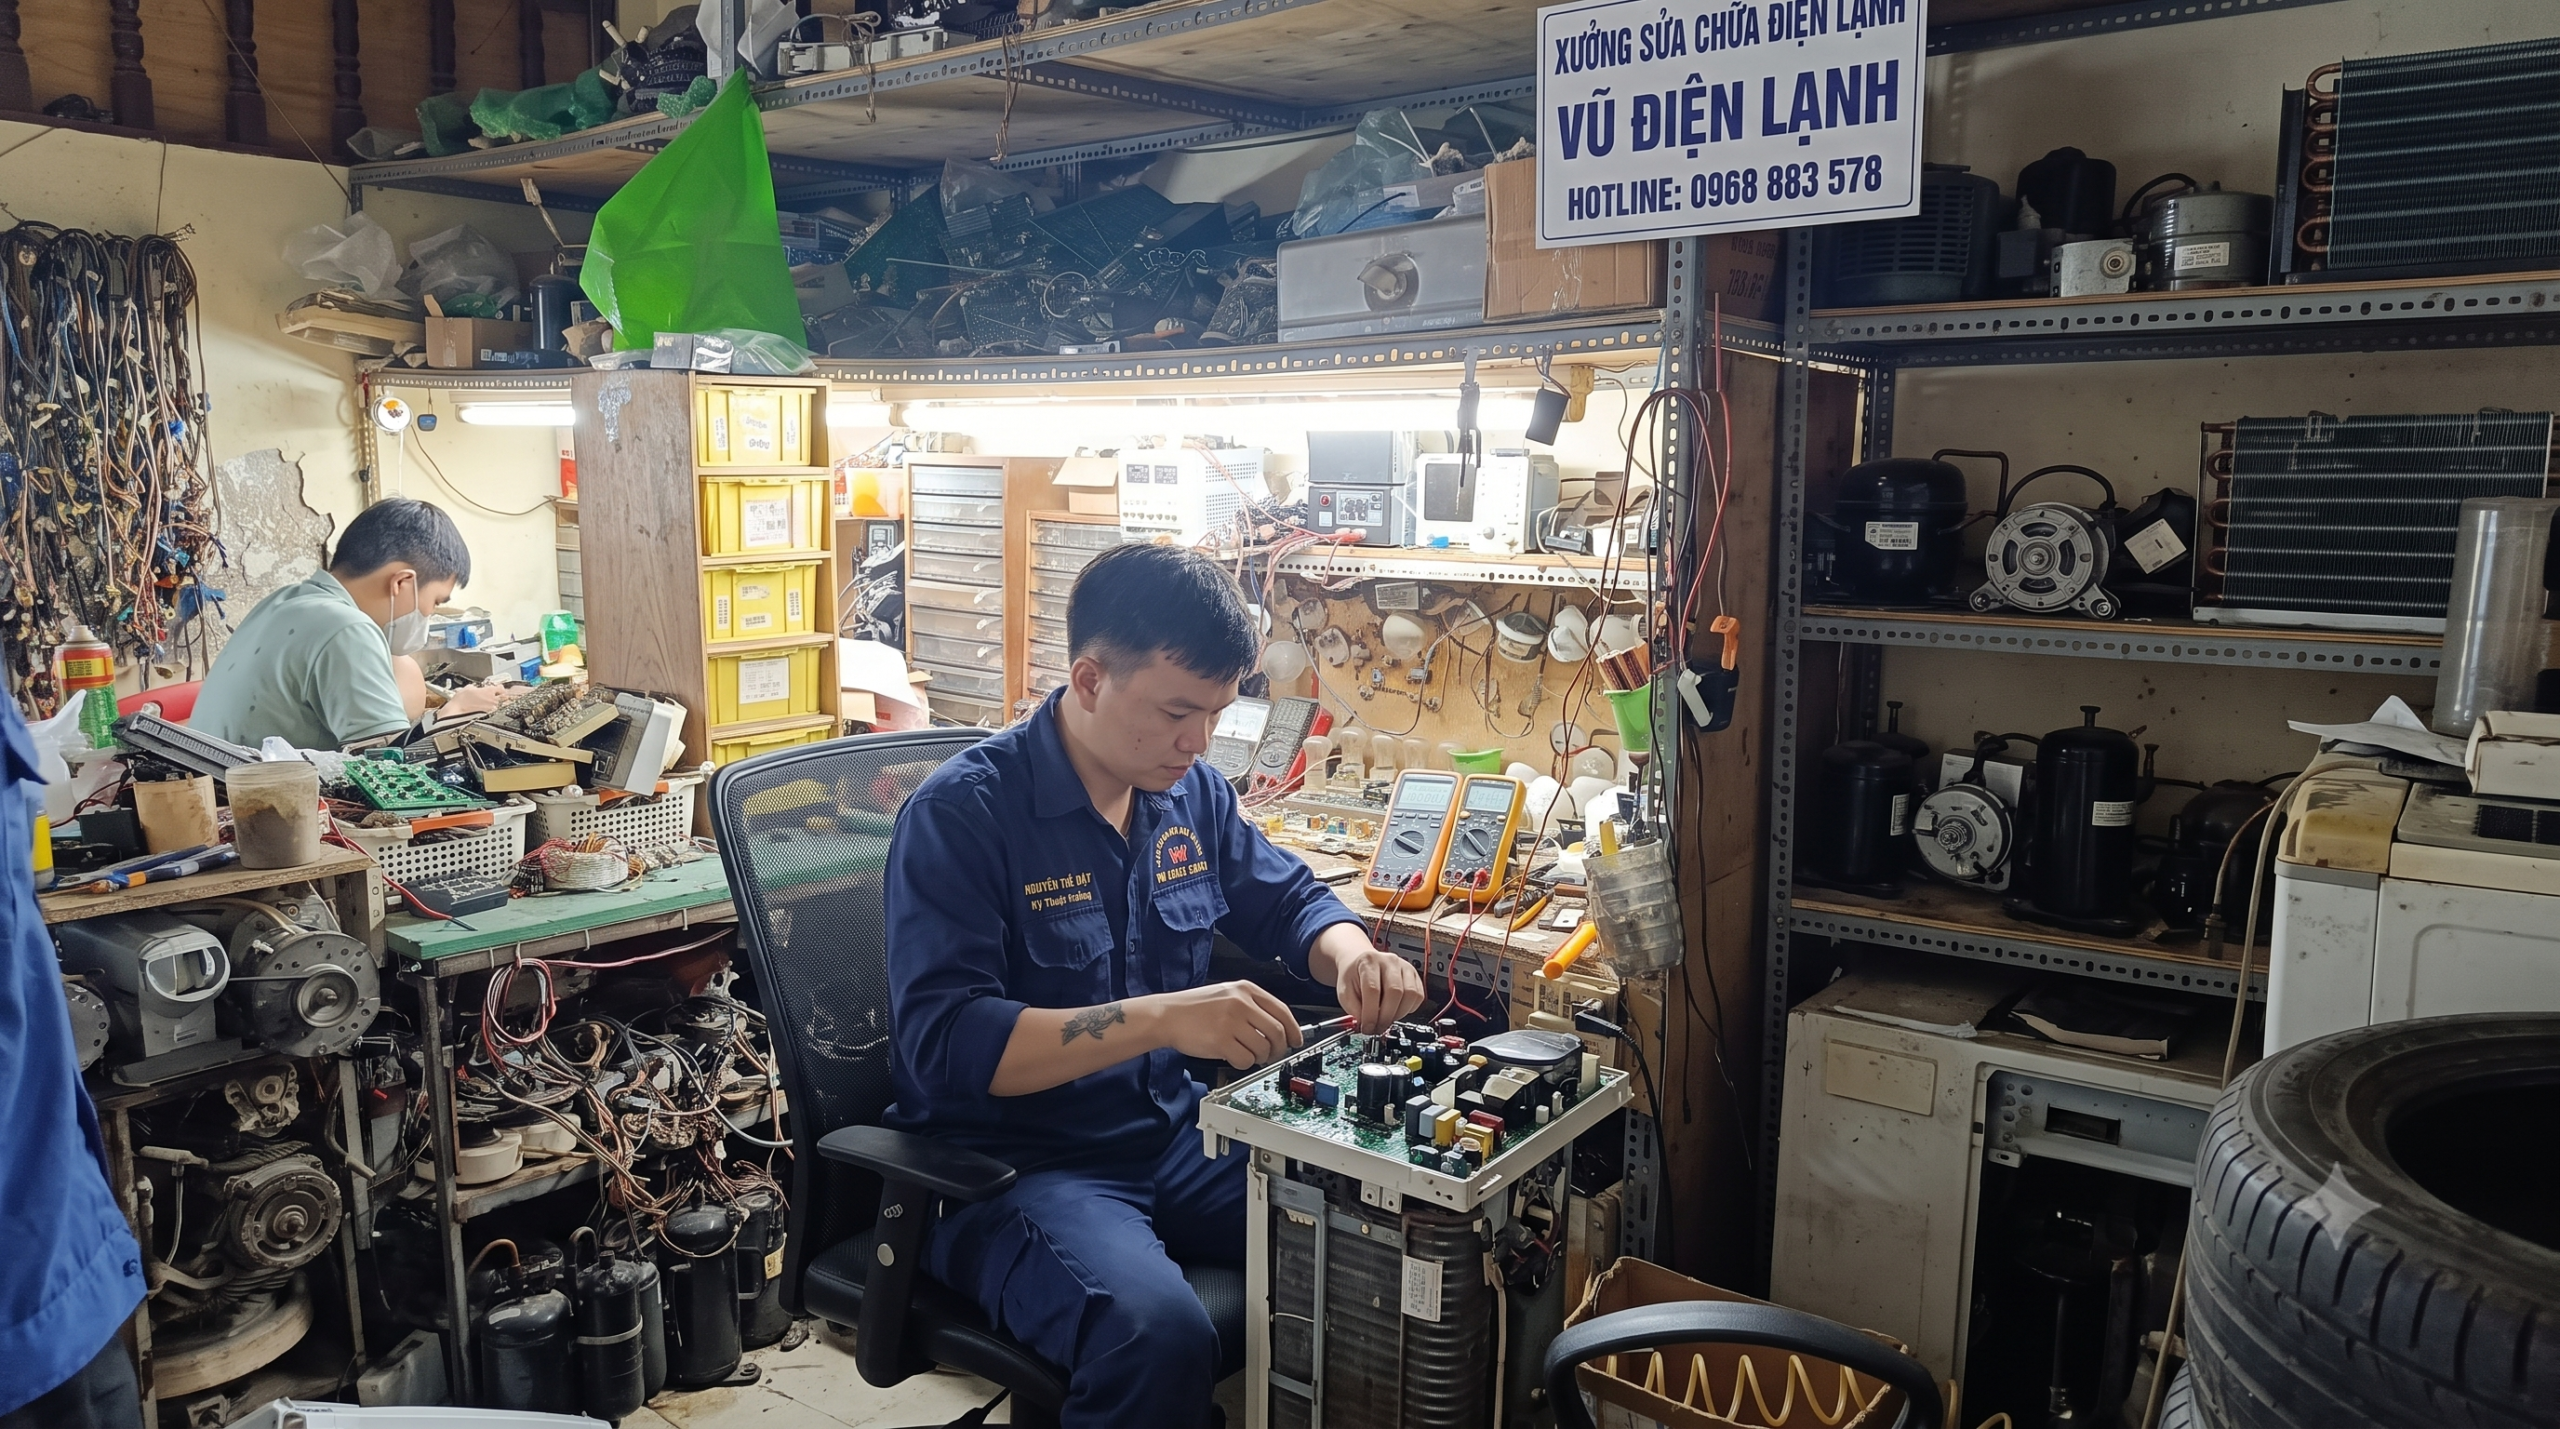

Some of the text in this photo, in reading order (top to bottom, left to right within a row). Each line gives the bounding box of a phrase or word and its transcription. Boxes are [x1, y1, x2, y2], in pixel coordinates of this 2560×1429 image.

[1555, 19, 1632, 75] XƯỞNG
[1640, 7, 1687, 62] SỬA
[1695, 1, 1760, 53] CHỮA
[1557, 59, 1899, 160] VŨ ĐIỆN LẠNH
[1568, 154, 1882, 221] HOTLINE: 0968 883 578
